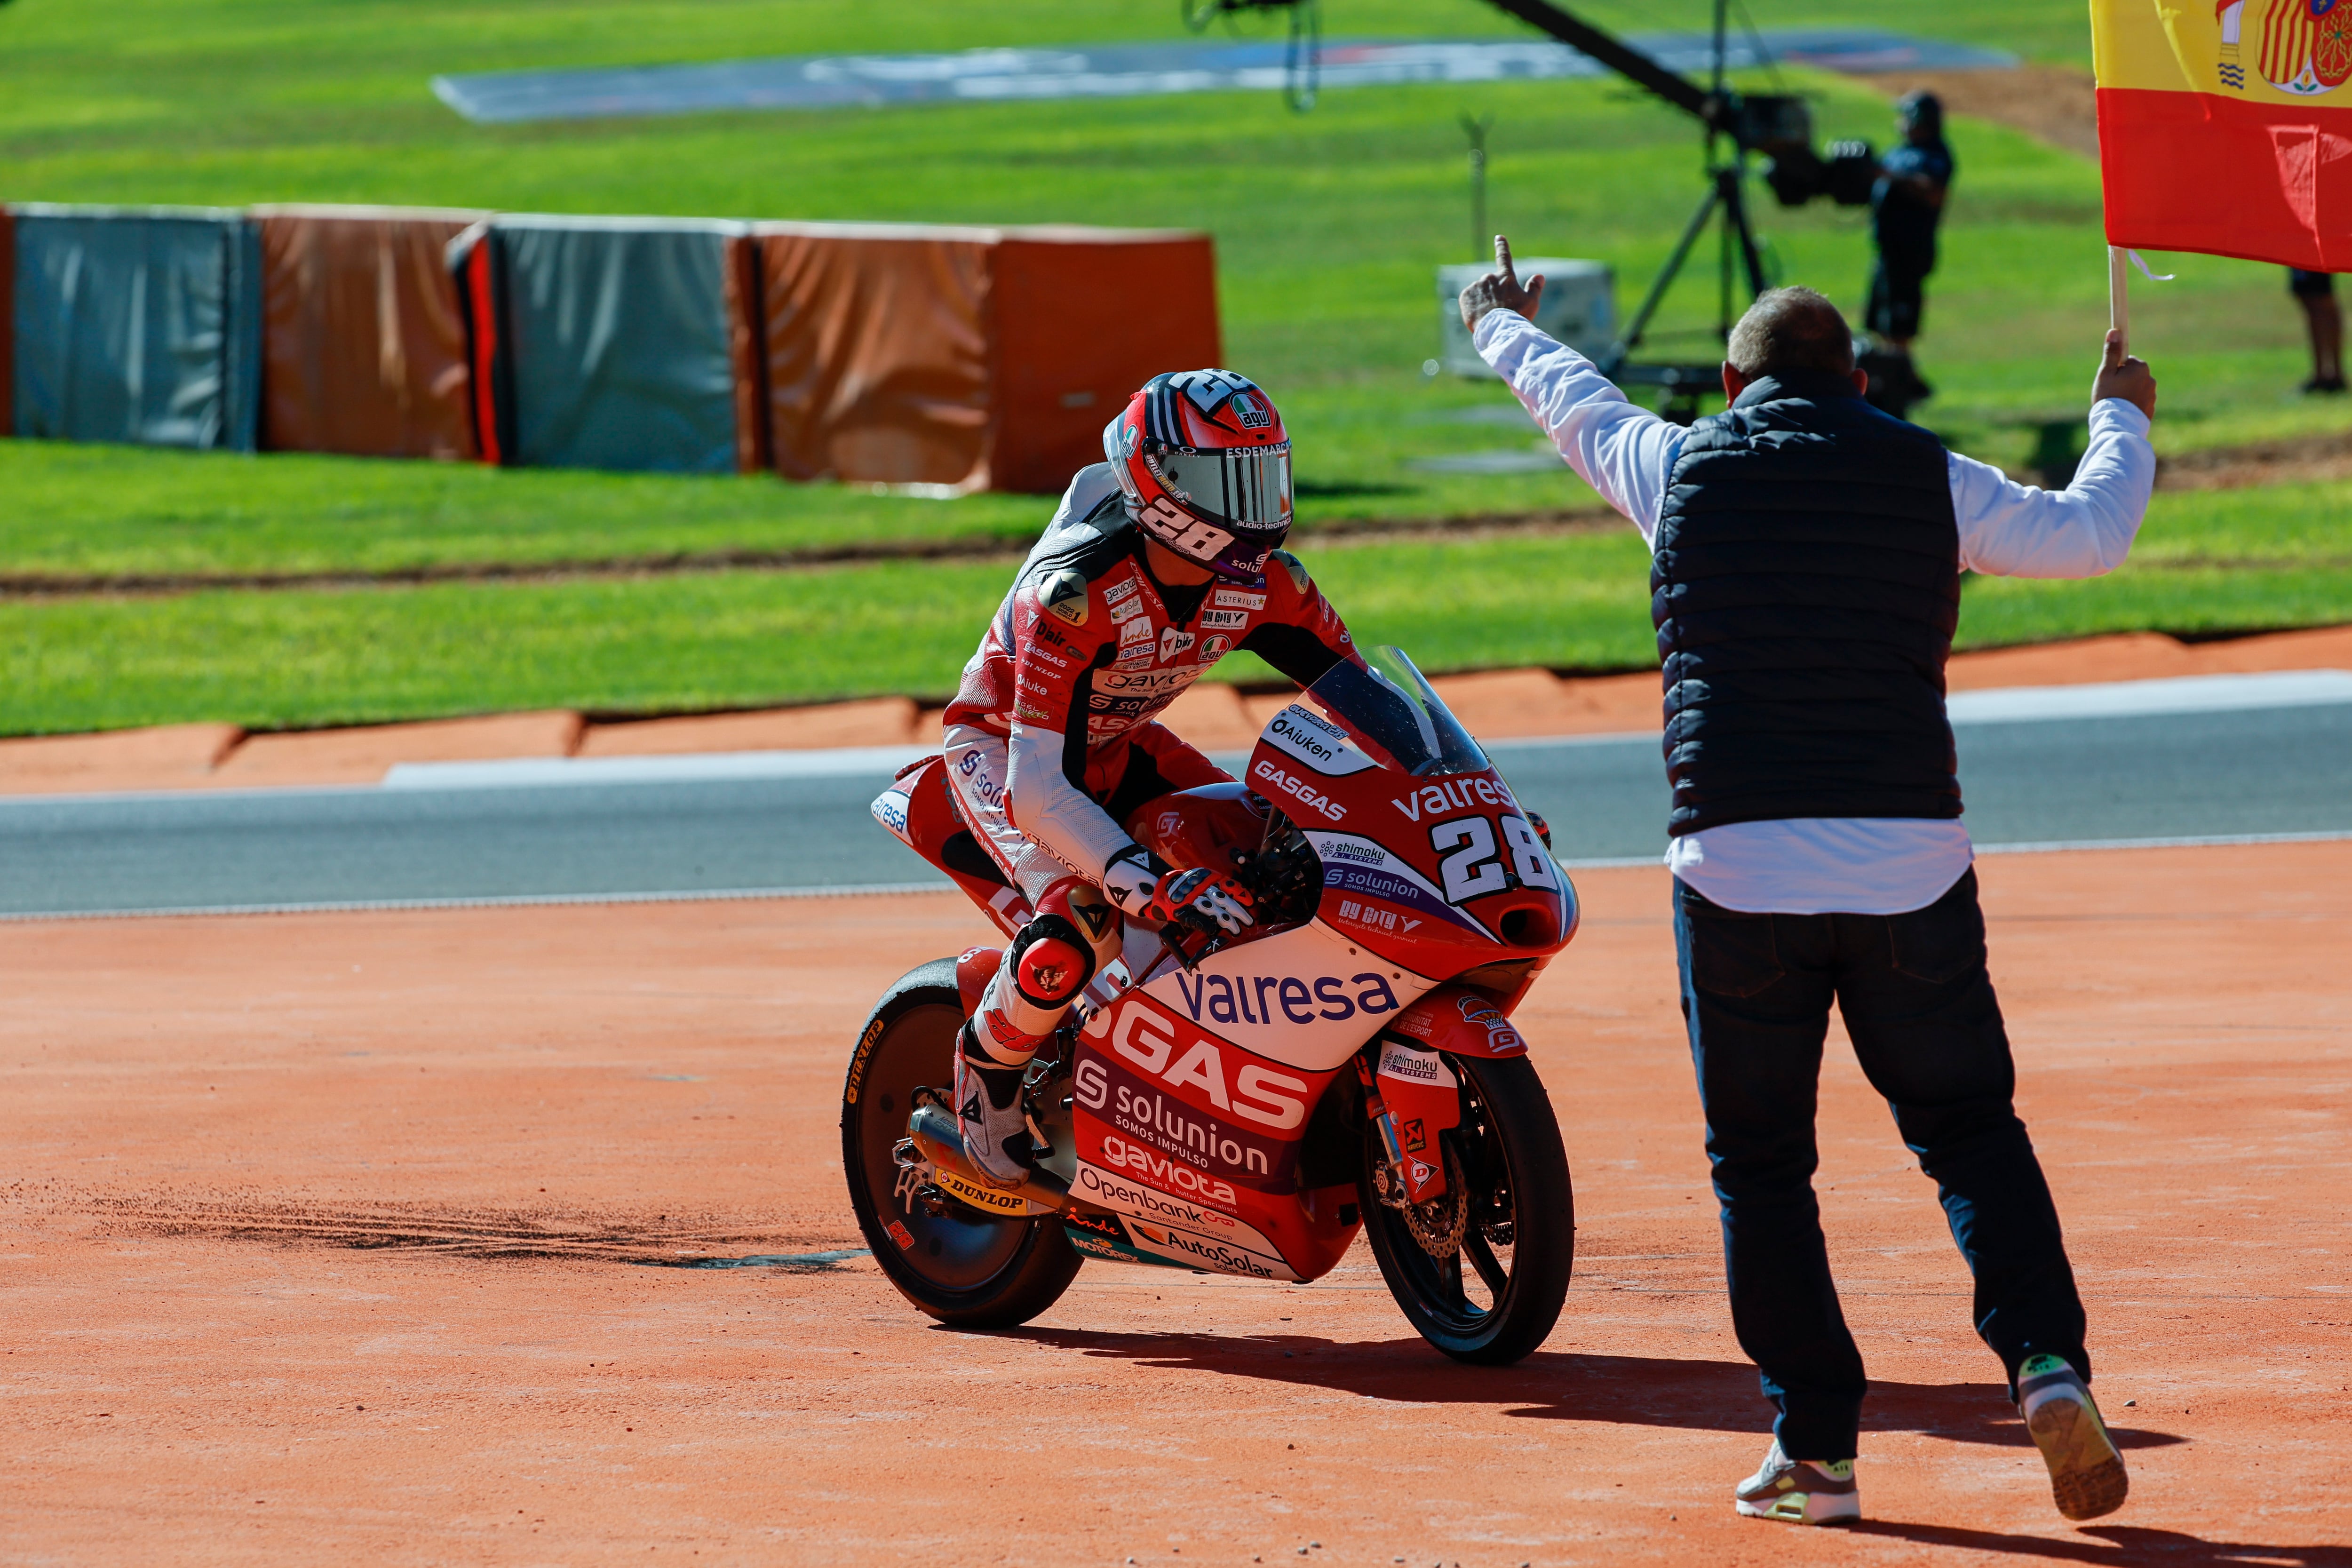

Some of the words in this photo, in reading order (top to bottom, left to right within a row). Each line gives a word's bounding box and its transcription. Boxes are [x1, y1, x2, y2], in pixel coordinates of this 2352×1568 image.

[1139, 497, 1235, 561] 28
[1236, 516, 1291, 530] audio-technica
[1105, 578, 1136, 602] gaviota
[1216, 596, 1256, 606] ASTERIUS
[1057, 607, 1072, 617] WORLD
[1059, 602, 1075, 614] 2022
[1024, 642, 1067, 668] GASGAS
[1255, 760, 1347, 821] GASGAS
[1391, 778, 1516, 822] valres
[872, 798, 906, 834] alresa
[971, 788, 986, 810] SOMOS
[984, 809, 1005, 833] IMPULSO
[1335, 843, 1385, 860] shimoku
[1349, 855, 1383, 866] SYSTEMS
[1431, 816, 1558, 904] 28
[1346, 872, 1419, 899] solunion
[1365, 887, 1390, 897] IMPULSO
[1338, 899, 1362, 920] BY
[1362, 906, 1397, 930] CITY
[1336, 918, 1367, 930] Motorcycle
[1367, 925, 1393, 938] technical
[1393, 933, 1417, 944] garment
[1399, 1020, 1407, 1029] DE
[1407, 1023, 1432, 1037] L'ESPORT
[1401, 1012, 1432, 1027] COMUNITAT
[850, 1021, 881, 1092] DUNLOP
[1392, 1053, 1438, 1072] shimoku
[1401, 1068, 1436, 1079] SYSTEMS
[1115, 1114, 1154, 1142] SOMOS
[1158, 1136, 1208, 1168] IMPULSO
[1116, 1085, 1268, 1175] solunion
[1104, 1136, 1237, 1205] gaviota
[950, 1179, 1024, 1209] DUNLOP
[1080, 1168, 1207, 1224] Openbank
[1136, 1171, 1149, 1182] The
[1150, 1178, 1163, 1188] Sun
[1176, 1187, 1196, 1201] hutter
[1199, 1196, 1238, 1214] Specialists
[888, 1220, 914, 1250] 28
[1066, 1207, 1119, 1235] inde
[1149, 1212, 1200, 1231] Santander
[1203, 1226, 1233, 1241] Group
[1071, 1237, 1140, 1263] MOTOREX
[1168, 1232, 1273, 1278] AutoSolar
[1214, 1263, 1239, 1274] solar
